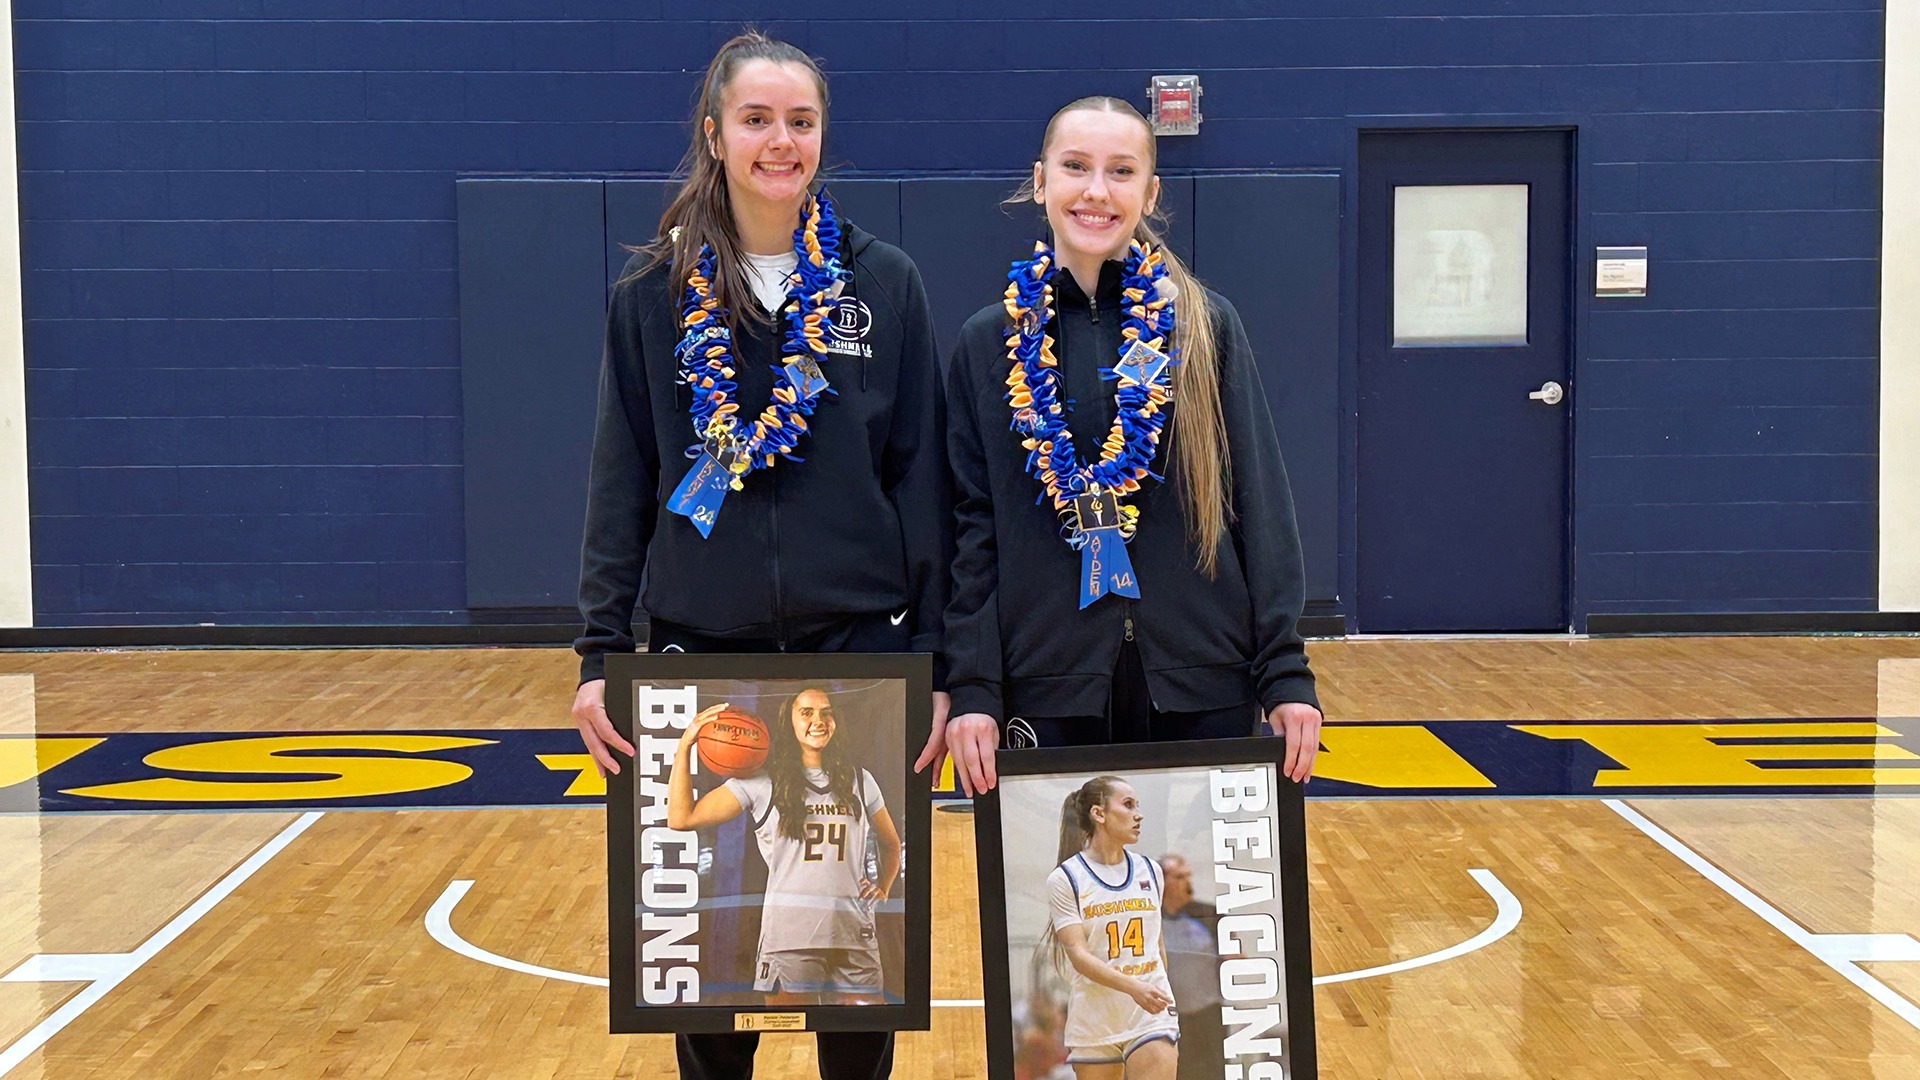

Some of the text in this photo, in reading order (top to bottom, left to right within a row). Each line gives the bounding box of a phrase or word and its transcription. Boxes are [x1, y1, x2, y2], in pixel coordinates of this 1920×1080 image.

[693, 505, 715, 525] 24
[1111, 572, 1133, 589] 14
[805, 804, 854, 817] SHNEL
[803, 822, 847, 862] 24
[1106, 917, 1144, 960] 14
